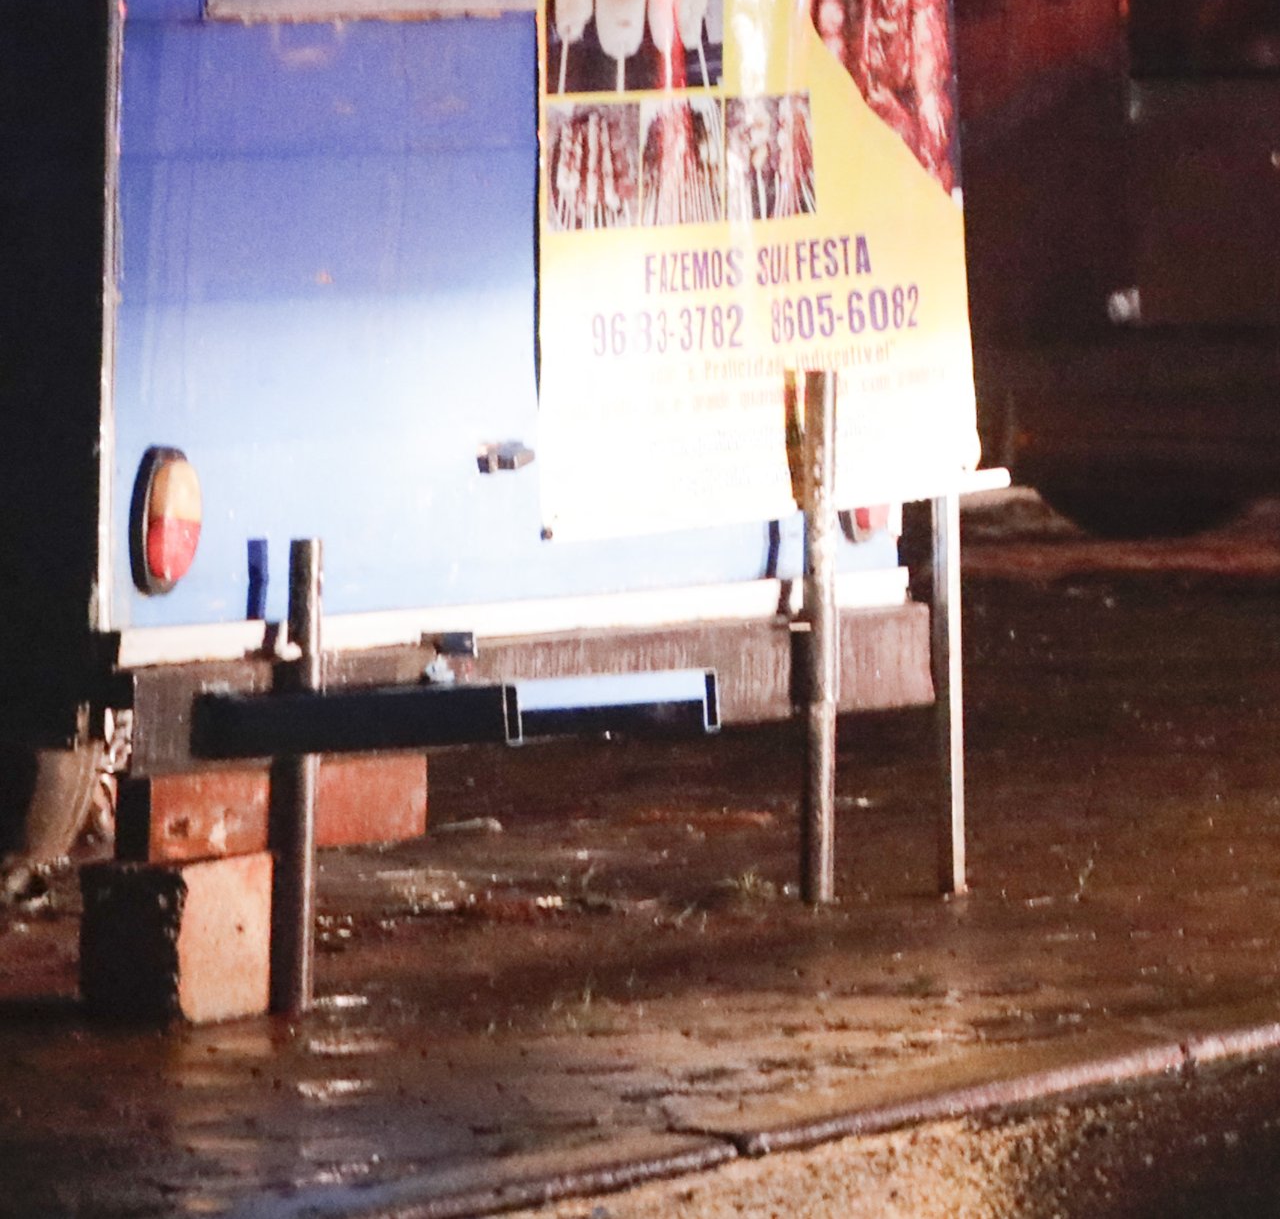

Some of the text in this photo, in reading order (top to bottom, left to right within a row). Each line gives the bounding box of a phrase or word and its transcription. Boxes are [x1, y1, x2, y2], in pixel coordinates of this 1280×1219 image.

[644, 246, 746, 294] FAZEMOS
[796, 233, 872, 282] FESTA
[770, 283, 919, 345] 8605-6082
